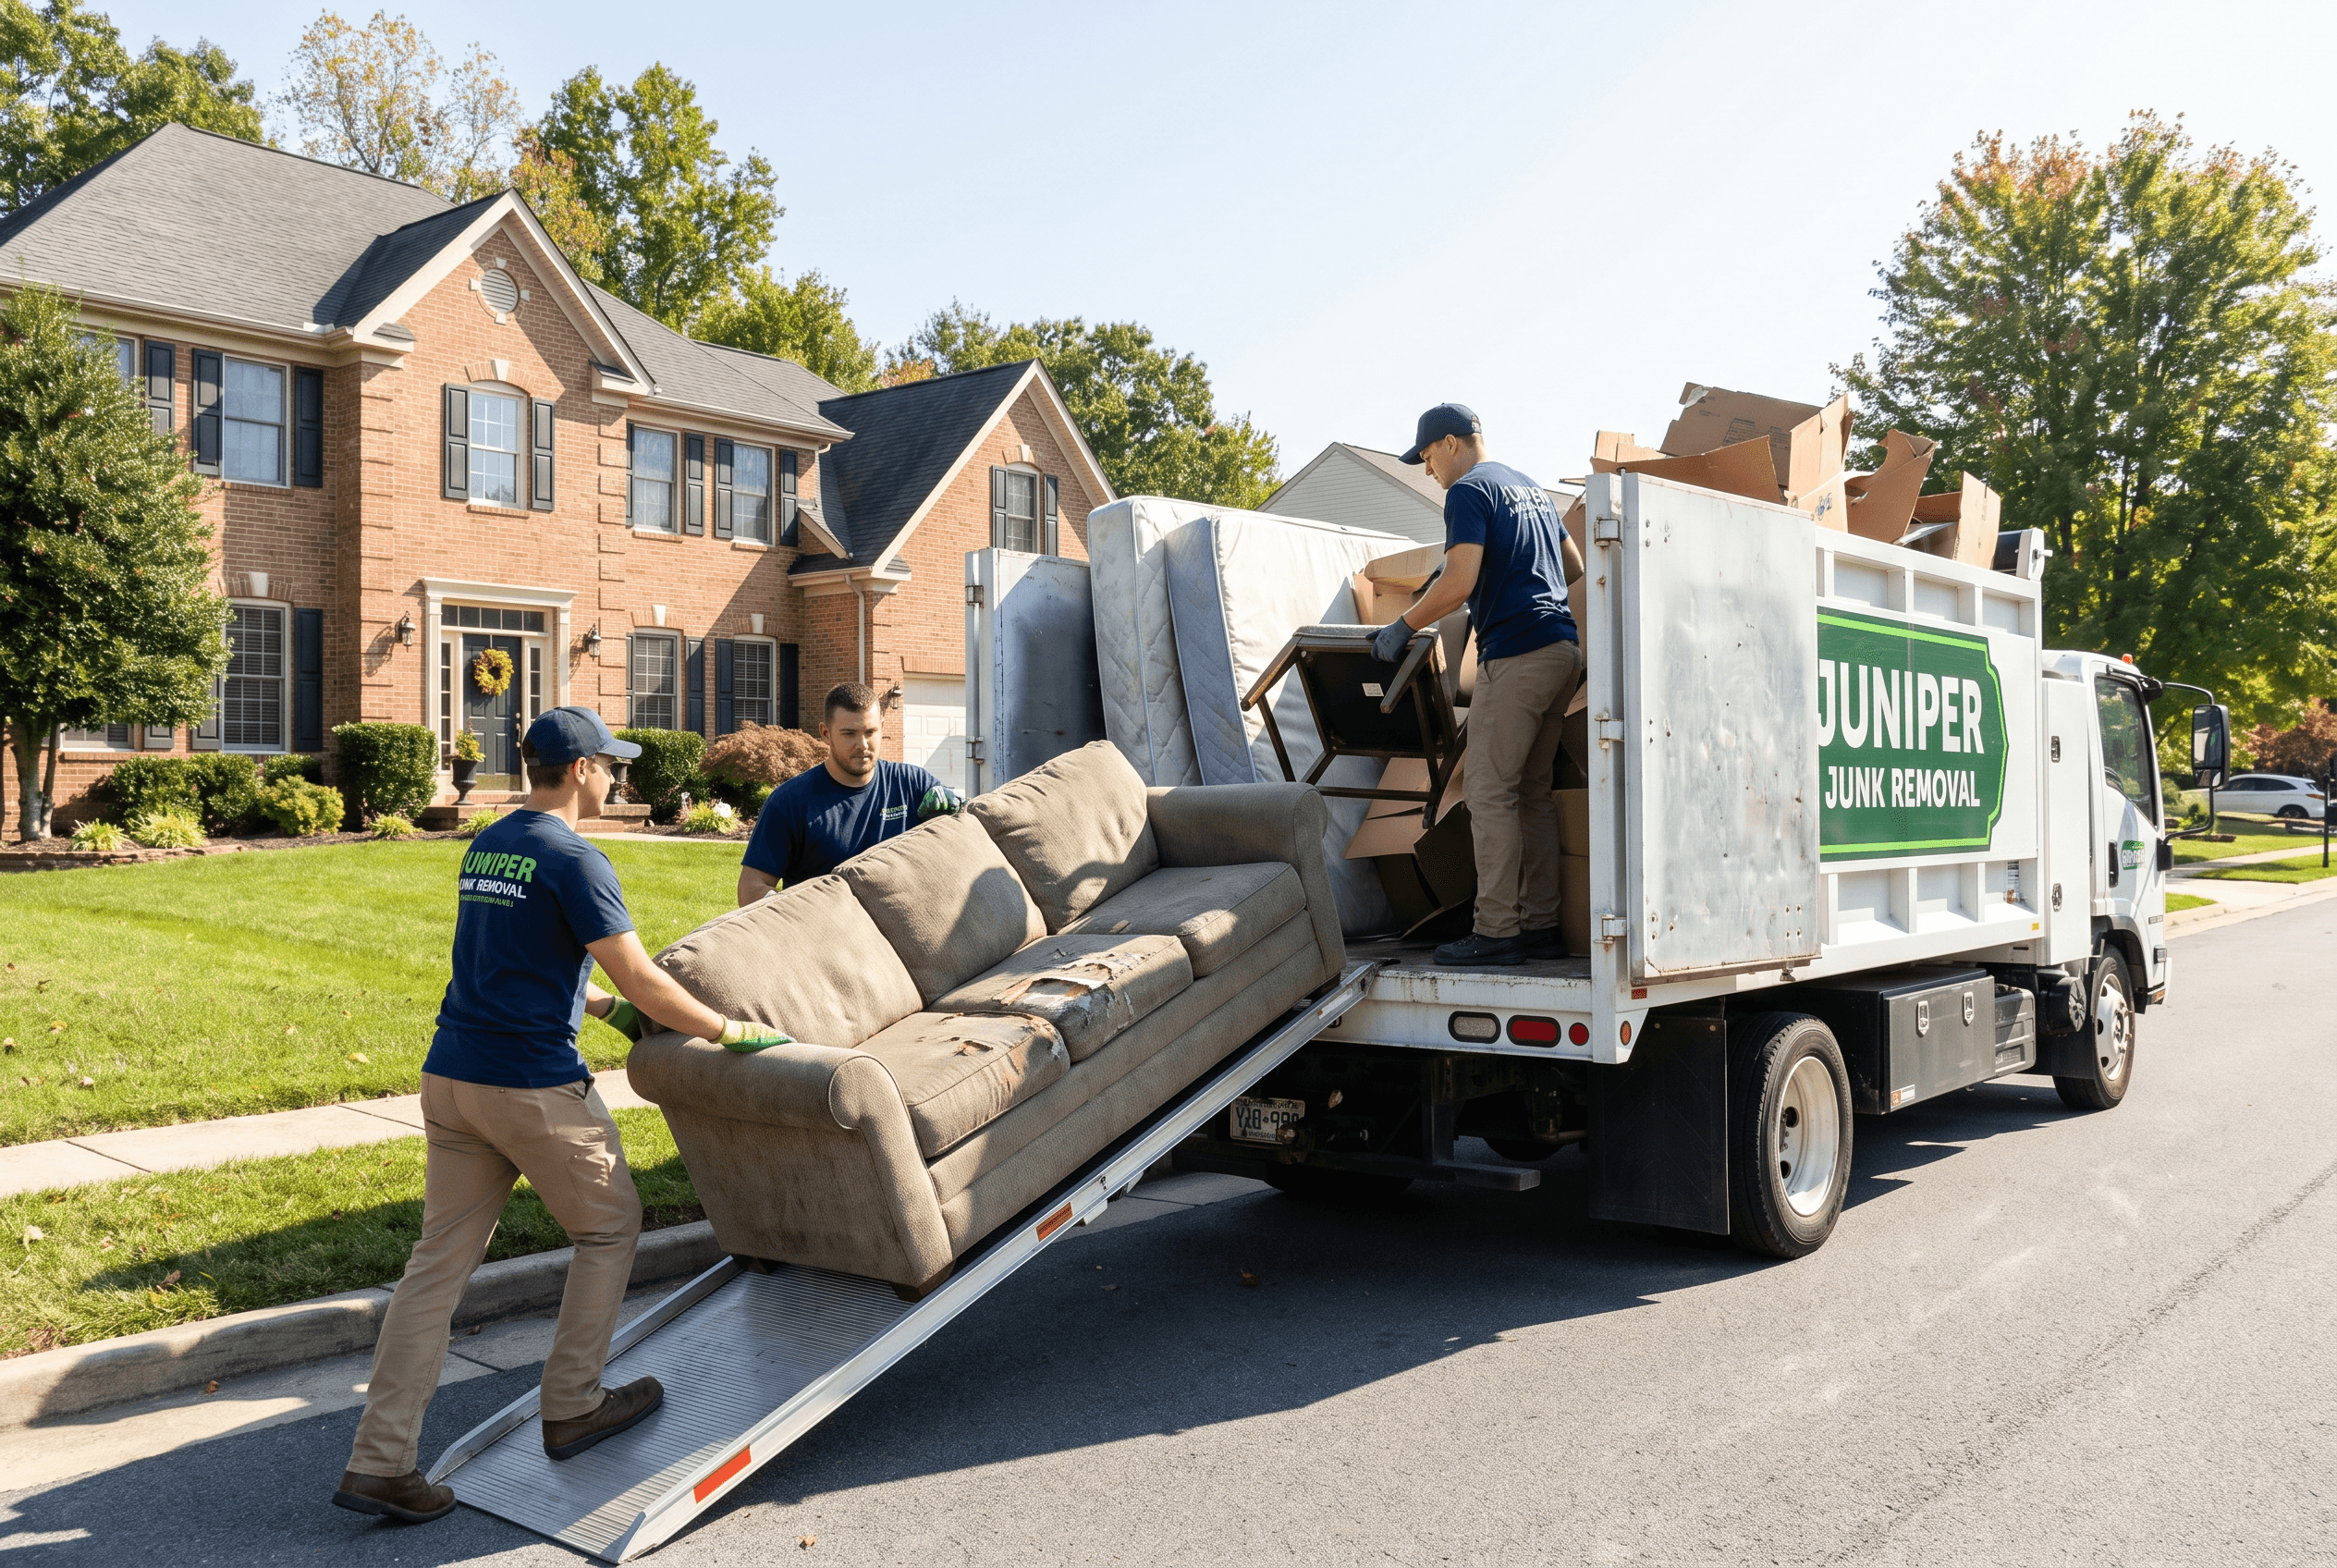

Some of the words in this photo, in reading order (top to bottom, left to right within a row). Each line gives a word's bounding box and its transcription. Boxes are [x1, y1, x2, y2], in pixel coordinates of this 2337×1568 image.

[1818, 658, 1985, 754] JUNIPER
[1825, 766, 1886, 809] JUNK
[1891, 767, 1980, 808] REMOVAL
[476, 878, 526, 899] REMOVAL
